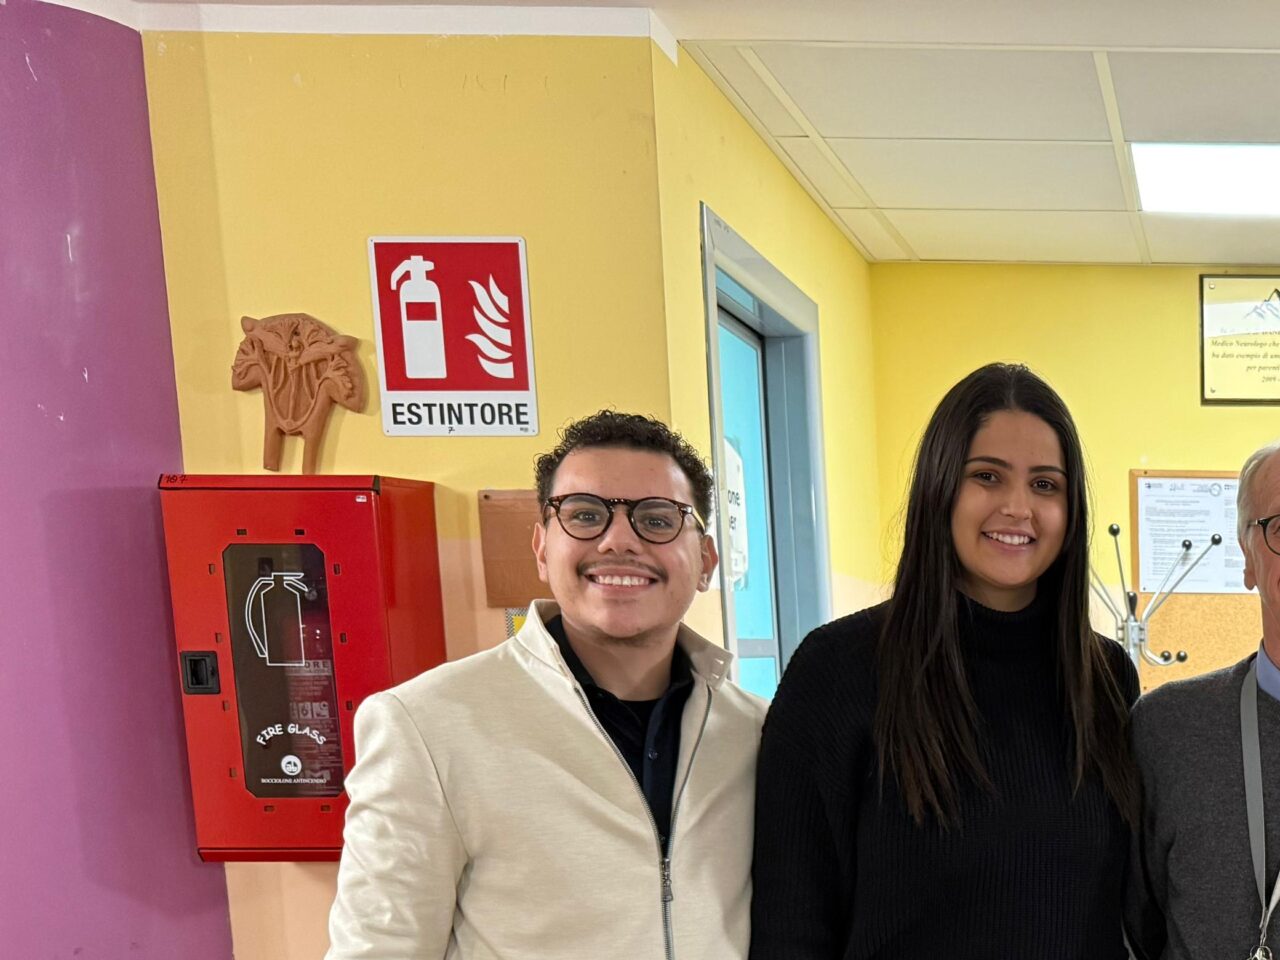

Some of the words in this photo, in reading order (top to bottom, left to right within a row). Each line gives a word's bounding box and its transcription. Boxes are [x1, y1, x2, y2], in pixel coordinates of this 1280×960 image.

[392, 402, 529, 426] ESTINTORE
[256, 723, 283, 746] FIRE
[287, 723, 327, 746] GLASS
